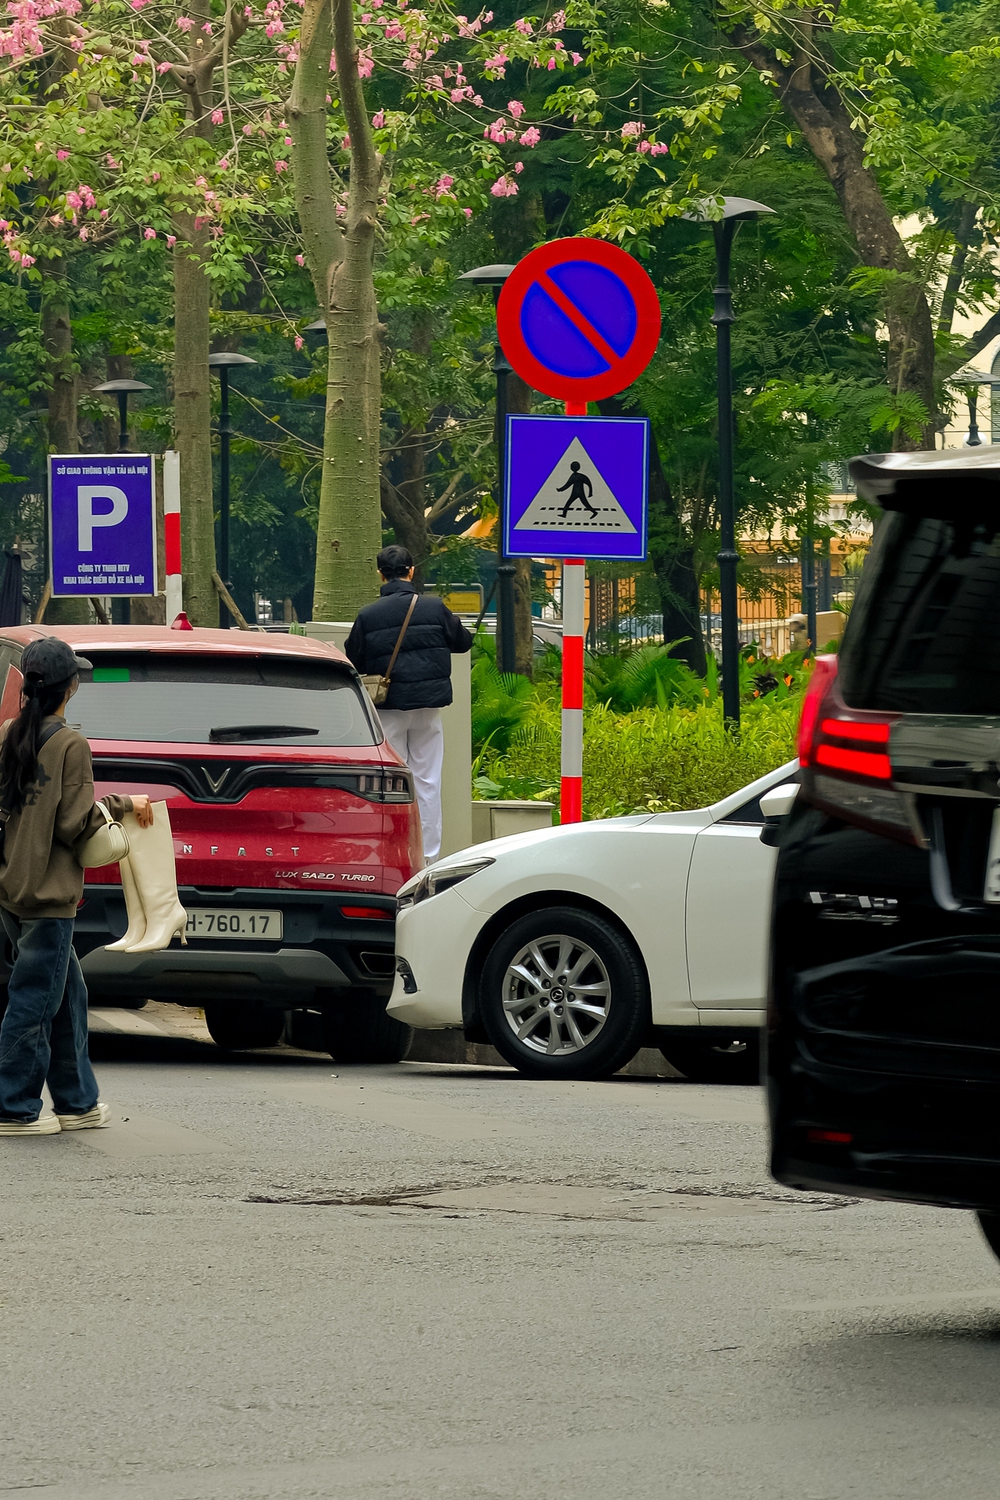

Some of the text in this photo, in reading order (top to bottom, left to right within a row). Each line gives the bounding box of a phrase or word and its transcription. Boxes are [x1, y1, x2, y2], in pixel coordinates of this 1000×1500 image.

[57, 464, 148, 476] SỞ GIAO THÔNG VẬN TẢI HÀ NỘI
[77, 485, 129, 552] P
[77, 563, 93, 572] CÔNG
[94, 564, 101, 572] TY
[63, 576, 77, 584] KHAI
[78, 575, 92, 584] THÁC
[93, 573, 107, 584] ĐIỂM
[125, 575, 133, 583] HÀ
[134, 574, 144, 585] NỘI
[183, 844, 300, 857] NFAST
[340, 873, 376, 882] TURBO
[186, 914, 271, 934] H-760.17
